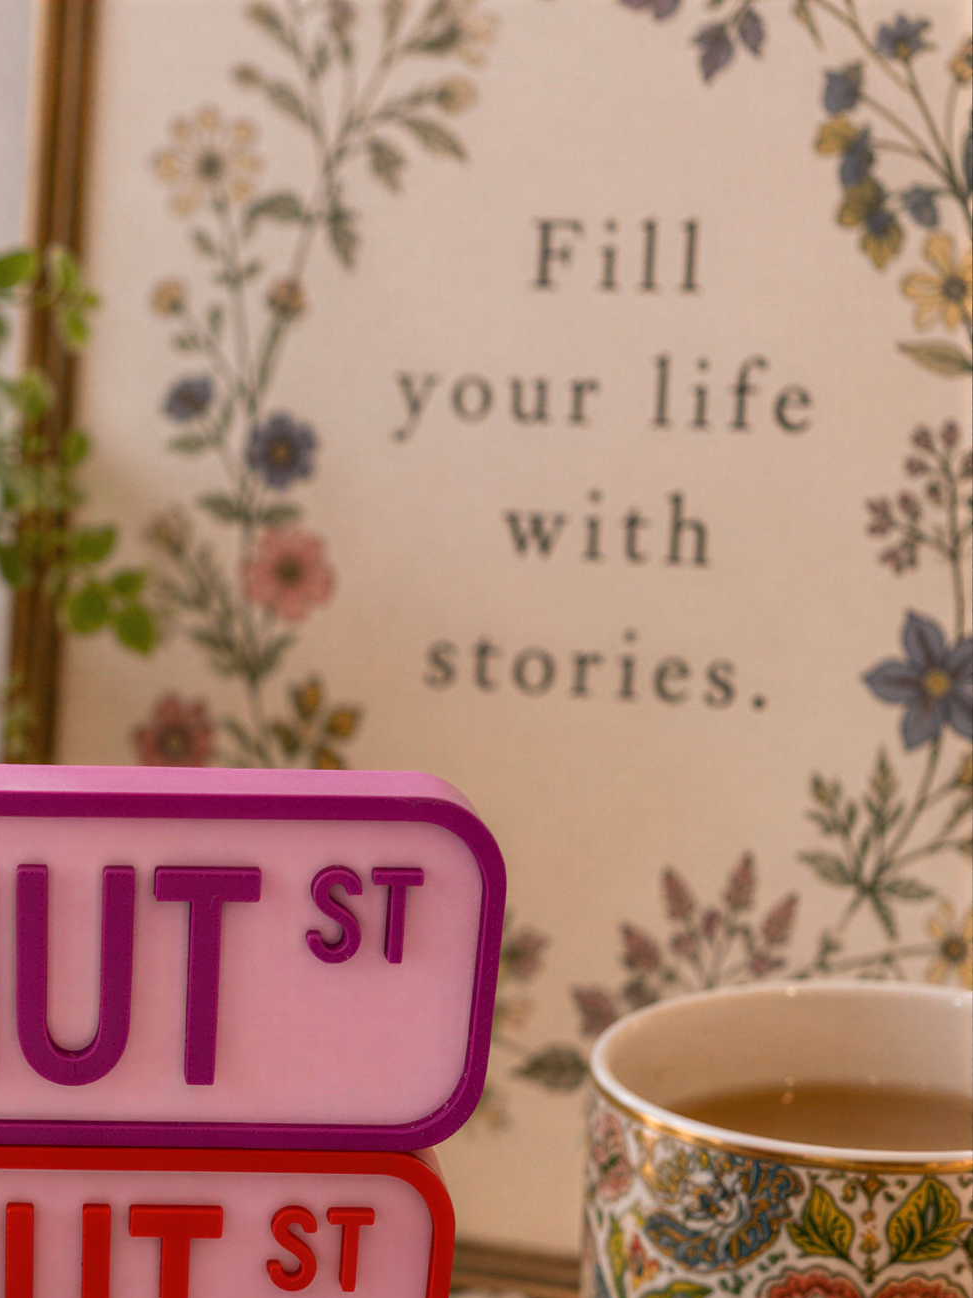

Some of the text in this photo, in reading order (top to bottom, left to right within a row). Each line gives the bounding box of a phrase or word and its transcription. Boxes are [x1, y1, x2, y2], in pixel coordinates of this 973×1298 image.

[532, 217, 701, 292] Fill
[390, 355, 815, 442] your life
[505, 490, 711, 566] with
[425, 629, 769, 709] stories.
[305, 864, 425, 965] ST
[266, 1205, 376, 1294] ST
